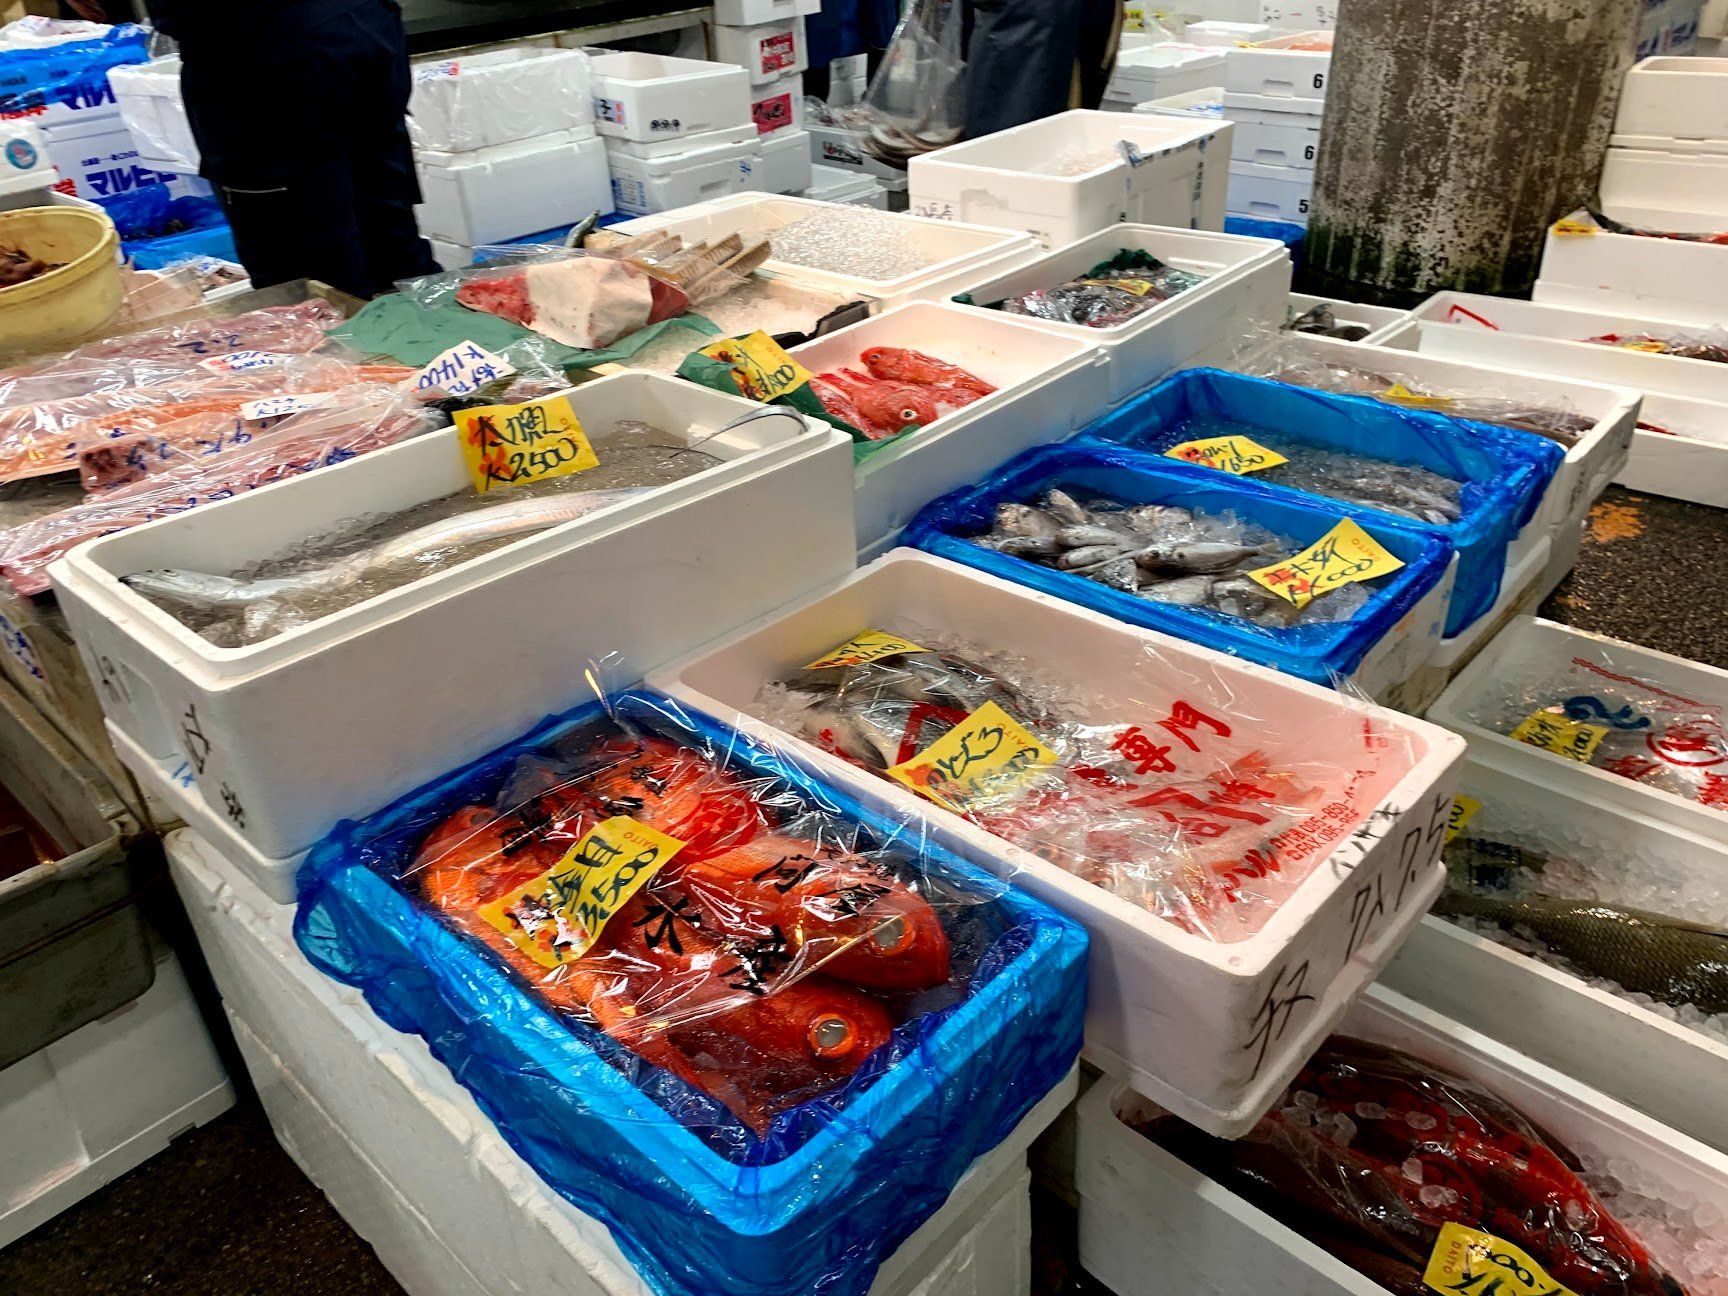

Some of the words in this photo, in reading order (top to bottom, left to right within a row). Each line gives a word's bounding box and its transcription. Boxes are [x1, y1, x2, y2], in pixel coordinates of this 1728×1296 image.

[1313, 73, 1324, 89] 6
[1304, 145, 1314, 161] 6
[1298, 199, 1309, 214] 5
[1443, 1240, 1461, 1274] DAITO
